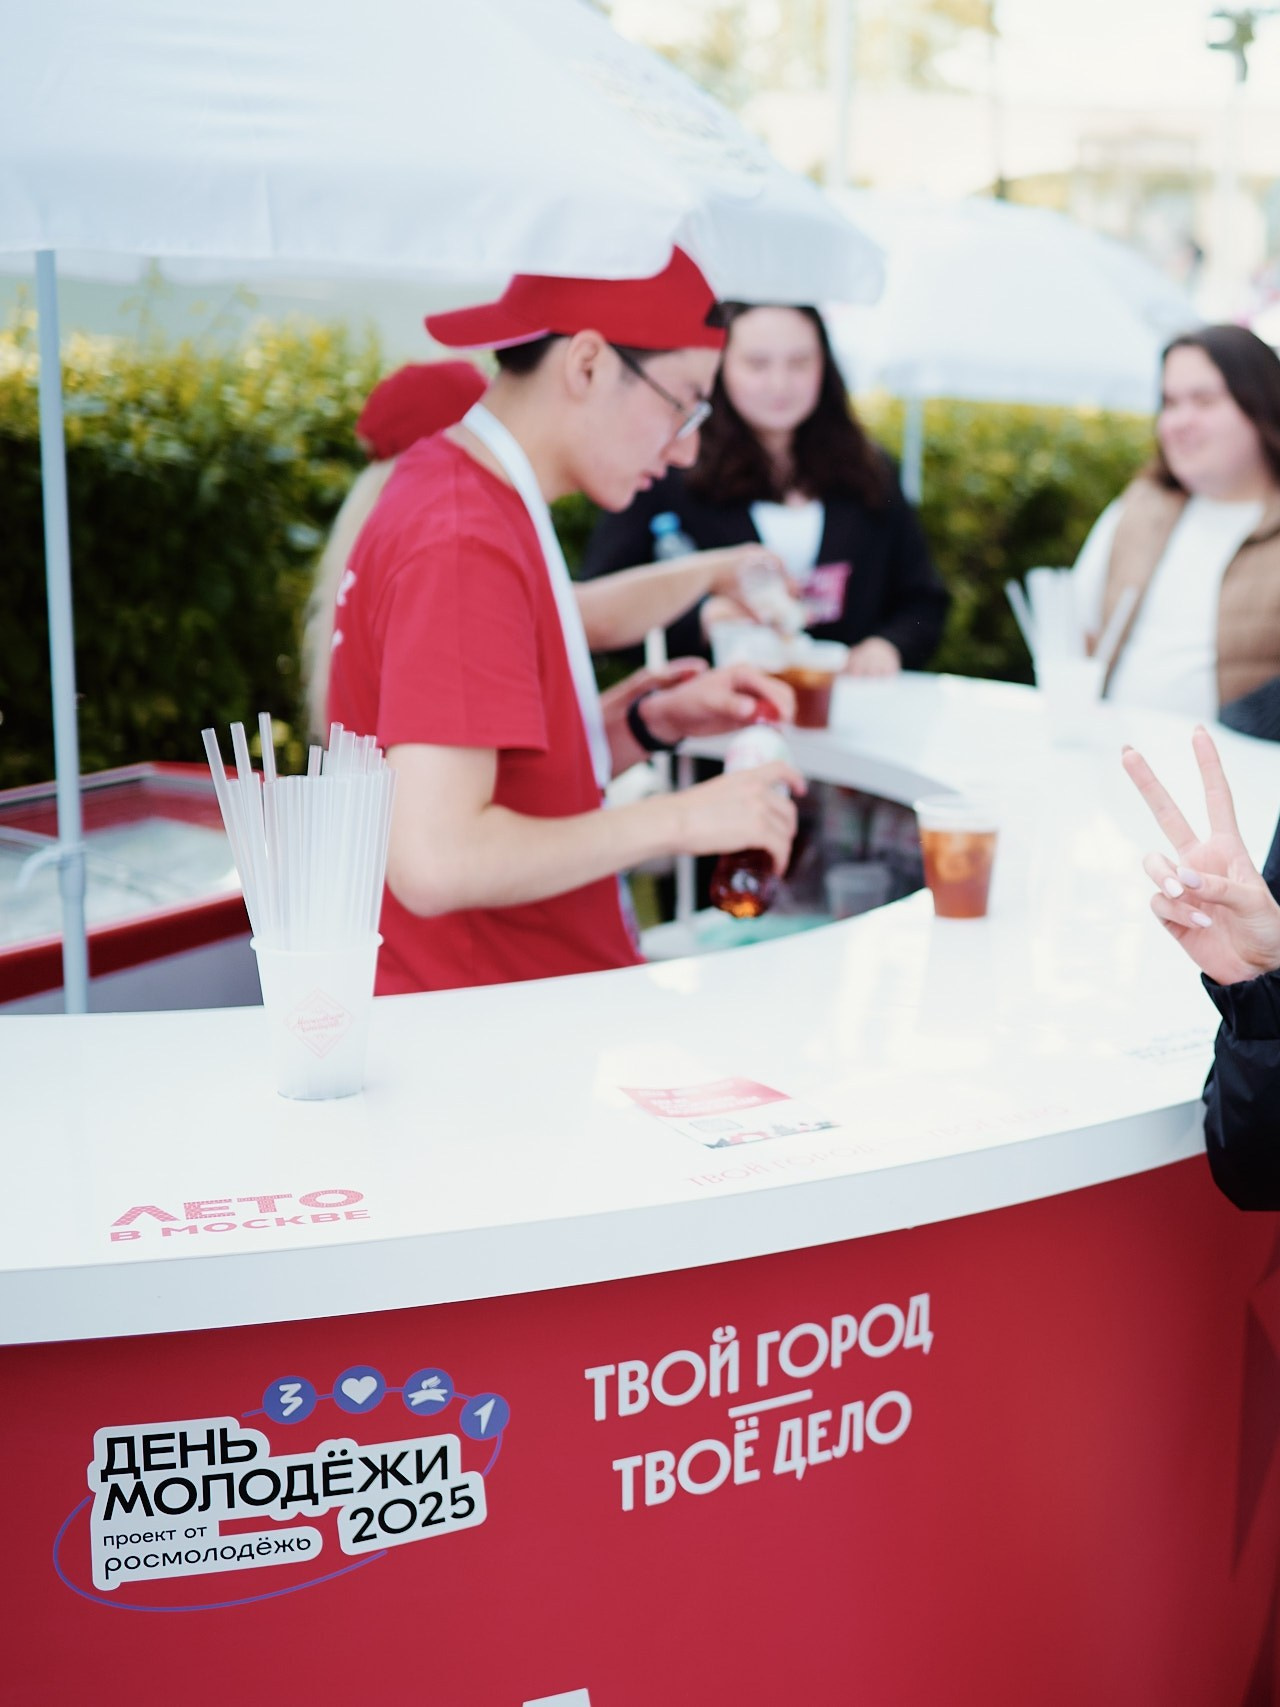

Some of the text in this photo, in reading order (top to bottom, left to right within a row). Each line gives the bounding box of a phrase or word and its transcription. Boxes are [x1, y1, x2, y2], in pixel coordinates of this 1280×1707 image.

[110, 1209, 371, 1242] В МОСКВЕ
[584, 1293, 933, 1421] ТВОЙ ГОРОД
[100, 1427, 258, 1482] ДЕНЬ
[612, 1390, 912, 1511] ТВОЁ ДЕЛО
[103, 1445, 450, 1520] МОЛОДЁЖИ
[103, 1527, 207, 1549] проект от
[349, 1484, 476, 1544] 2025
[104, 1534, 312, 1580] росмолодёжь
